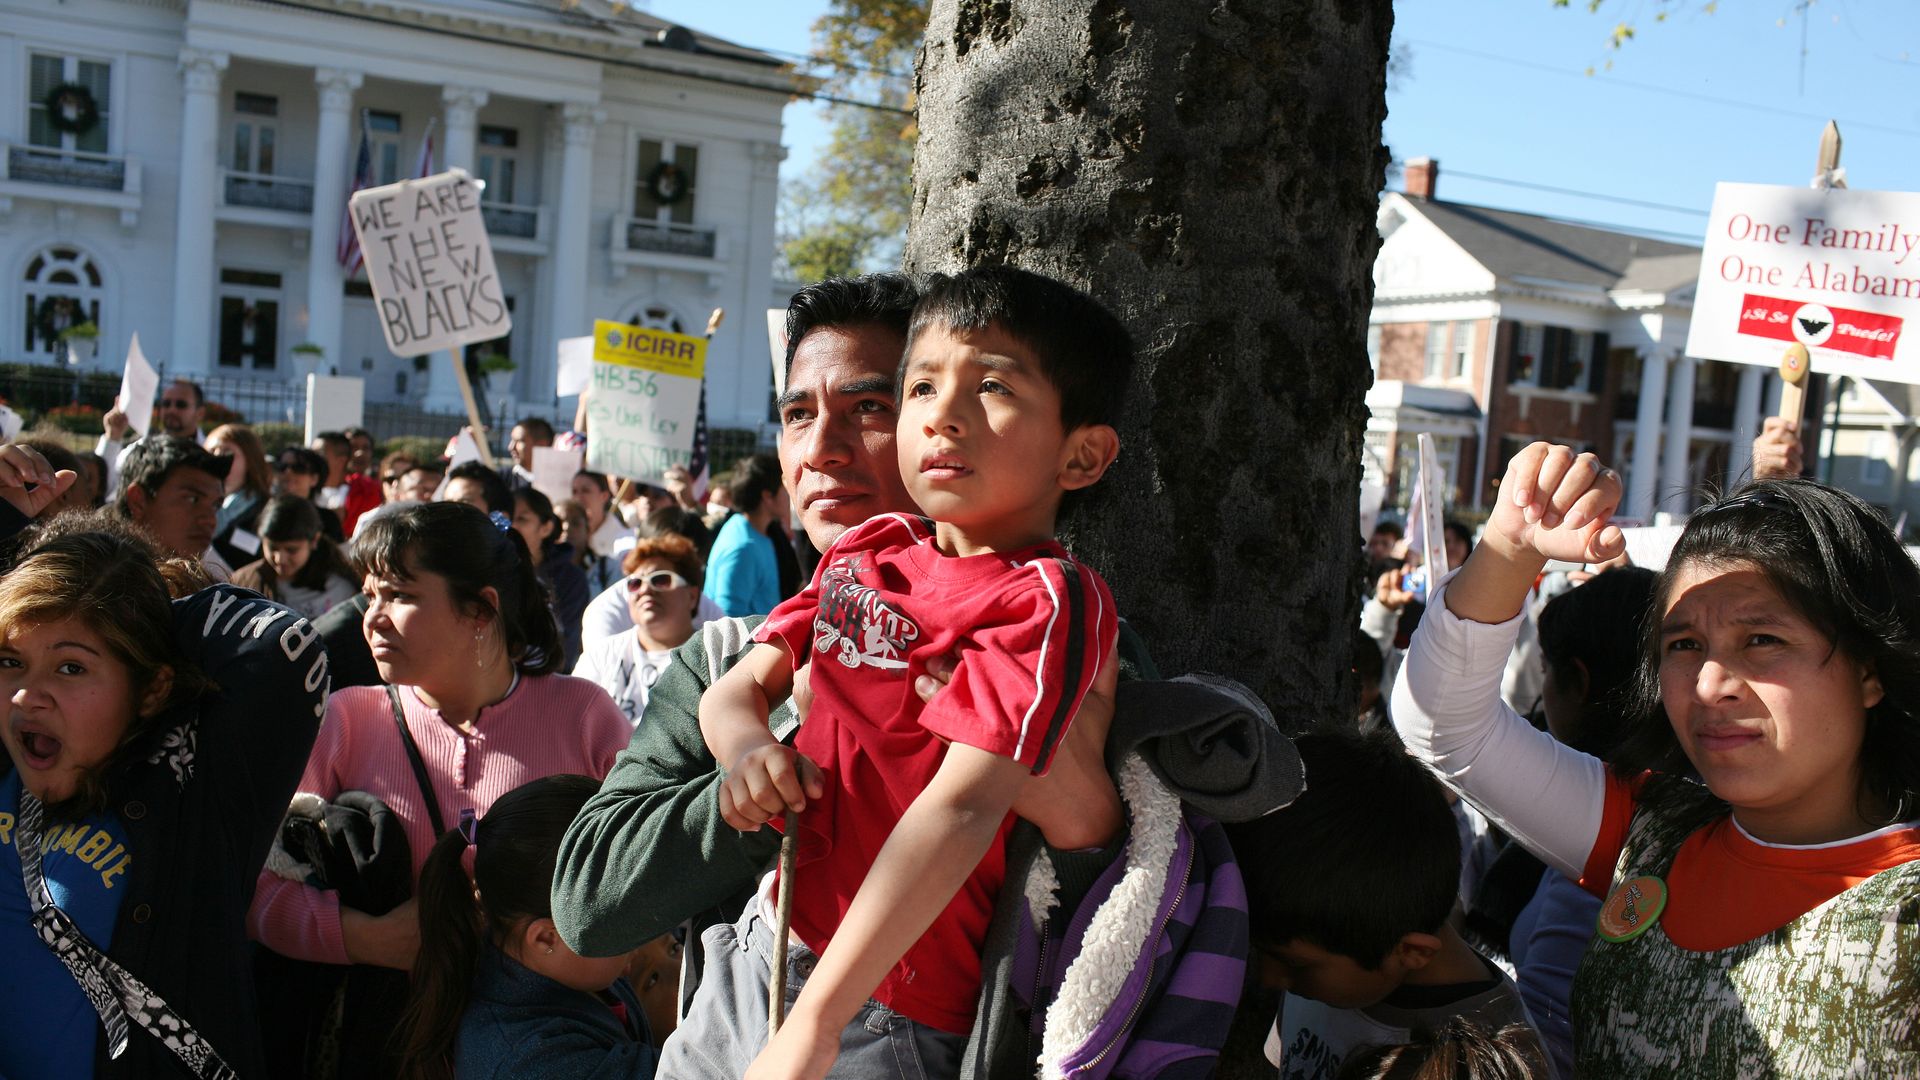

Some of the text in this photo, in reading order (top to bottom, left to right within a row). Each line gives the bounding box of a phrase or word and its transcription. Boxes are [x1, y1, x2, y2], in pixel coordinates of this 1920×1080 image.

[355, 180, 477, 233] WE ARE
[380, 219, 466, 263] THE
[1727, 212, 1791, 245] One
[387, 244, 481, 292] NEW
[1720, 254, 1783, 286] One
[381, 275, 505, 348] BLACKS
[1768, 311, 1790, 324] Se
[1836, 322, 1895, 343] Puede!
[626, 331, 696, 361] ICIRR
